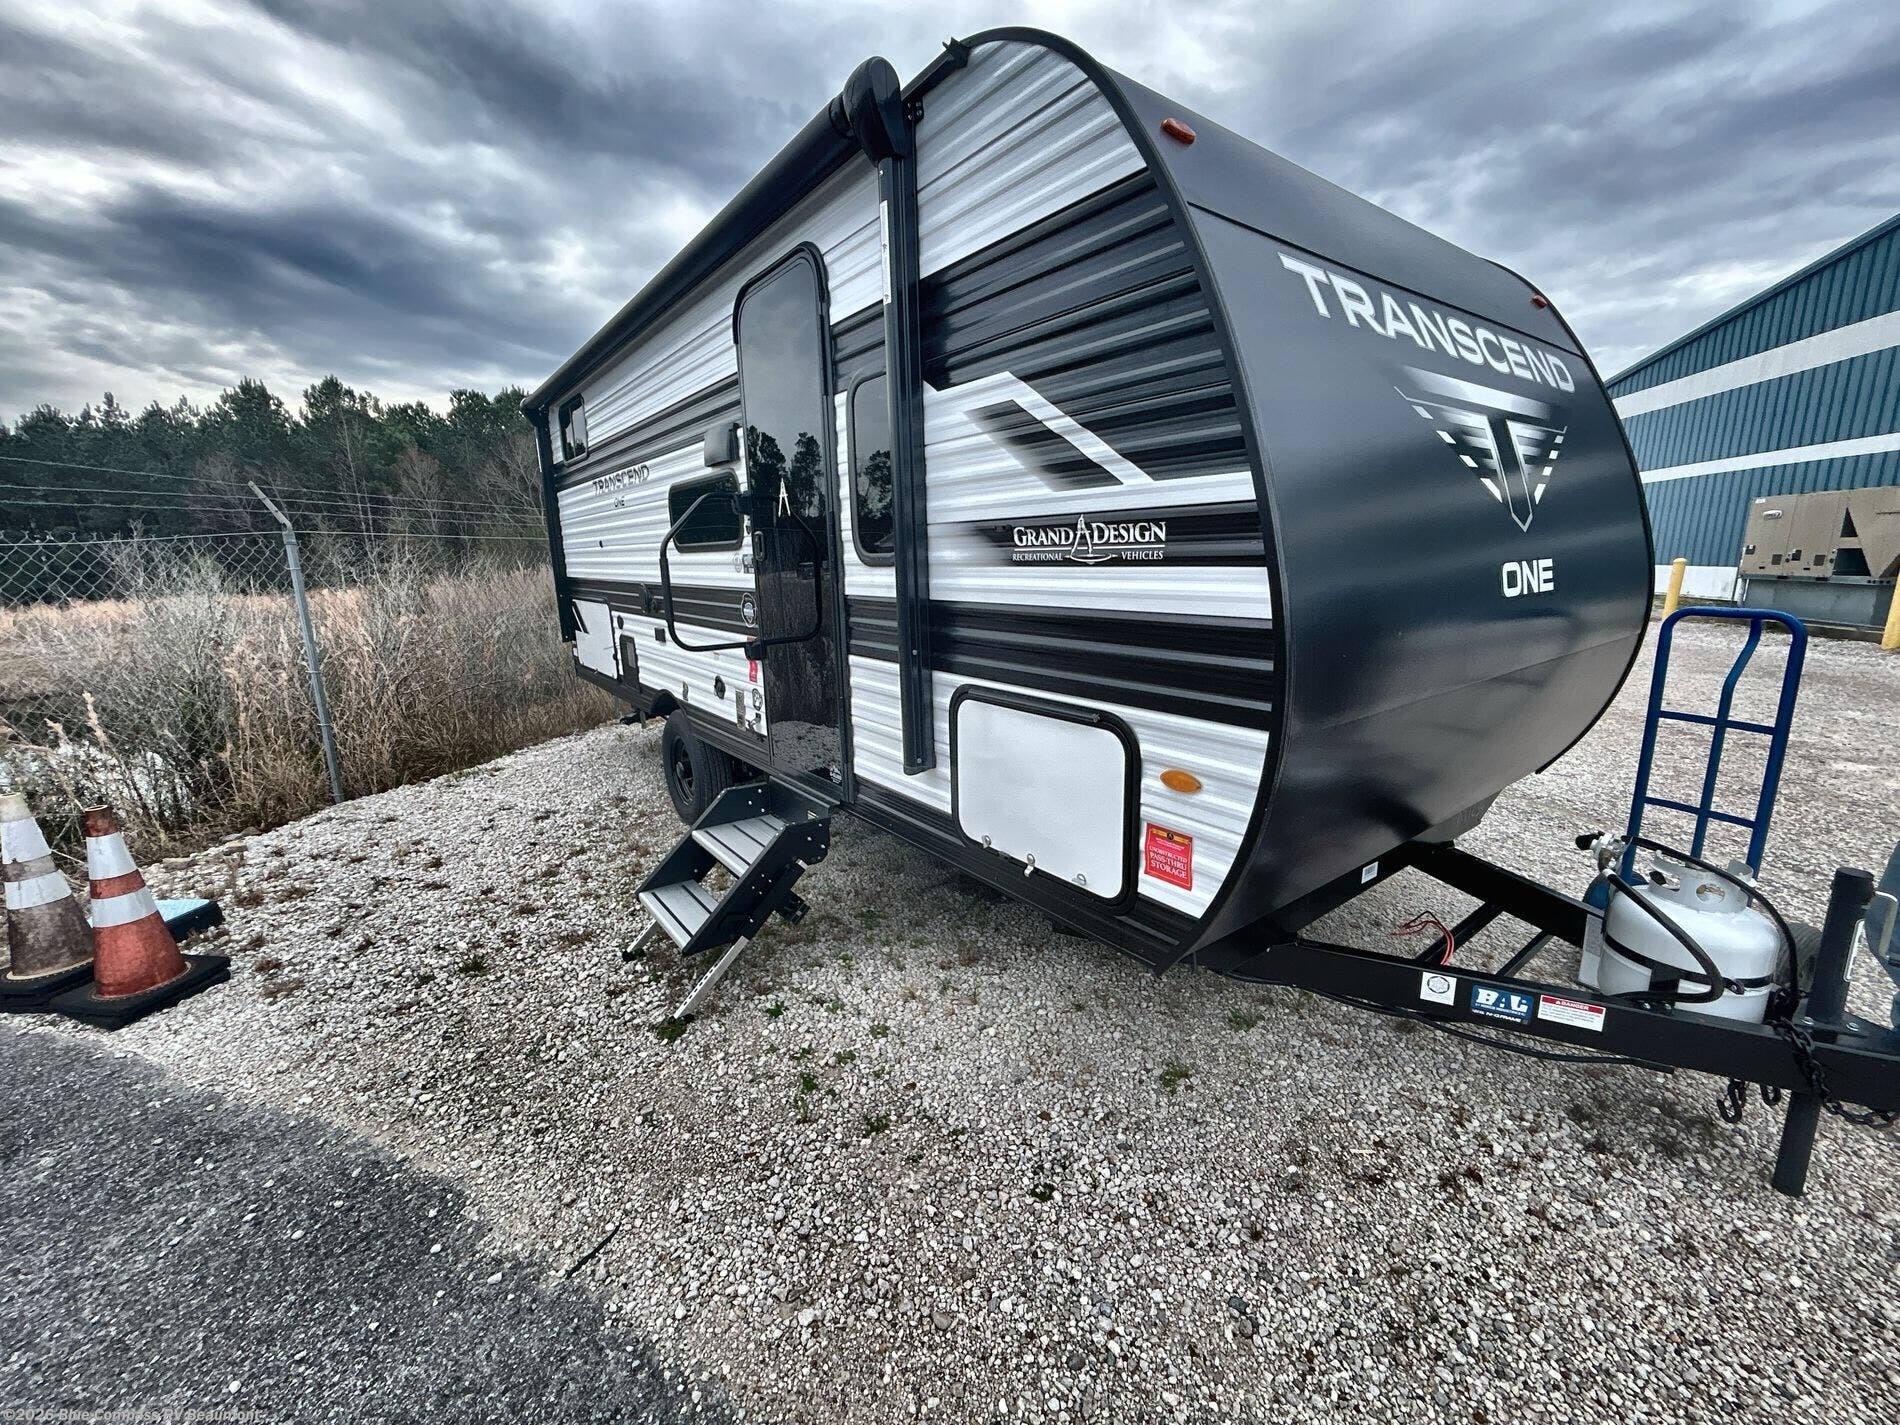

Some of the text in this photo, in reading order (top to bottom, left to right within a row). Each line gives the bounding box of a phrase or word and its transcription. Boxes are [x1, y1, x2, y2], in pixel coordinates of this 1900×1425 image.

[1278, 251, 1575, 393] TRANSCEND
[593, 464, 650, 495] TRANSCEND
[1014, 521, 1167, 547] GRAND DESIGN
[1012, 550, 1164, 561] RECREATIONAL VEHICLES
[1502, 558, 1554, 598] ONE
[1151, 860, 1188, 879] STORAGE
[1561, 1001, 1590, 1011] DANGER
